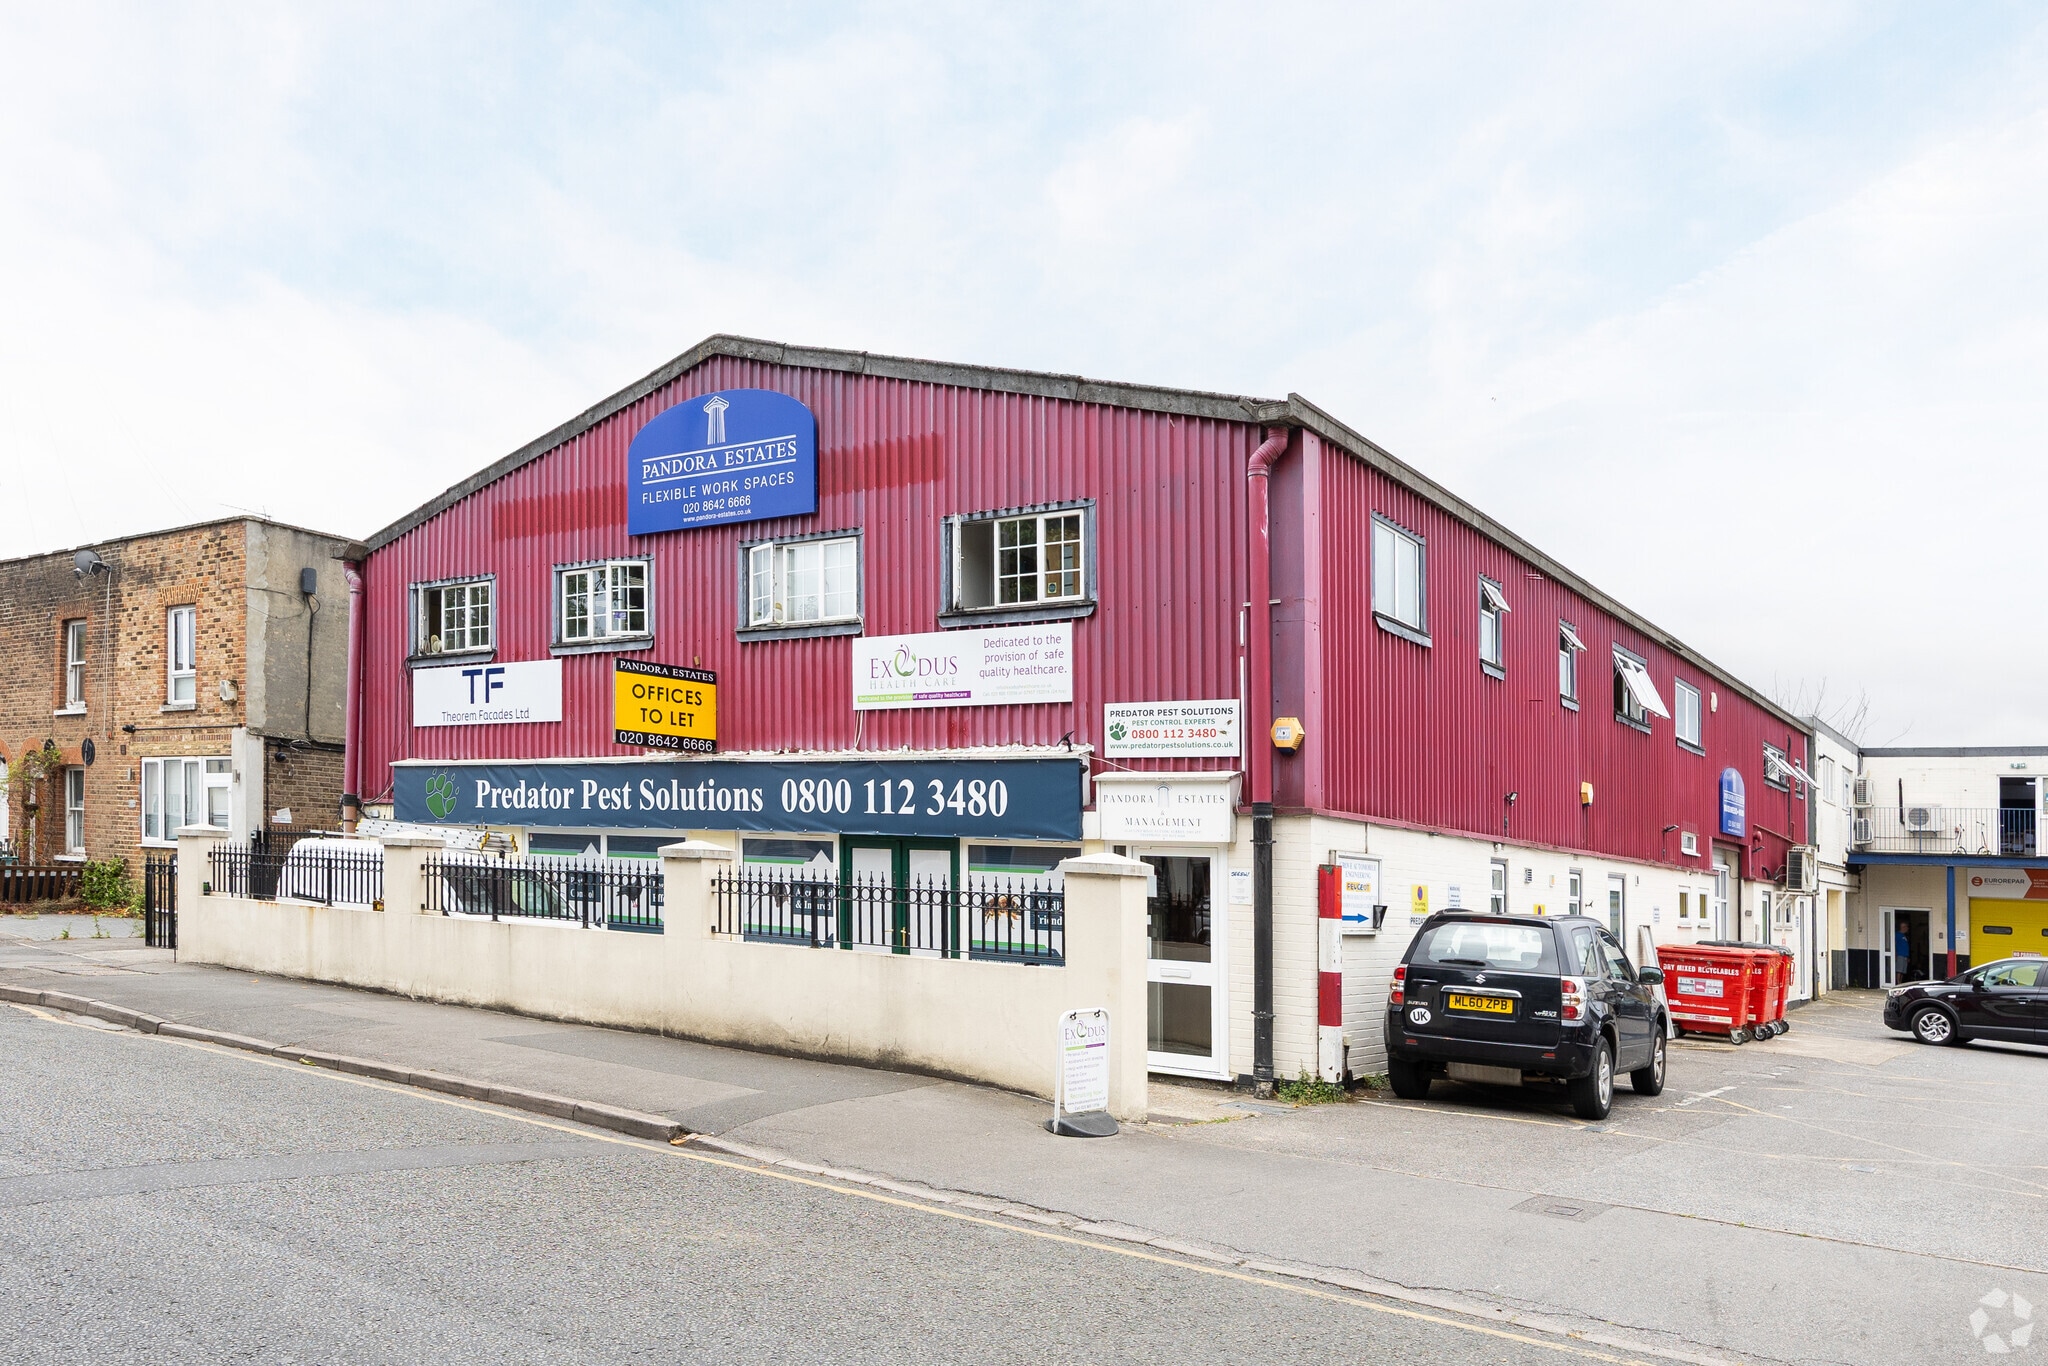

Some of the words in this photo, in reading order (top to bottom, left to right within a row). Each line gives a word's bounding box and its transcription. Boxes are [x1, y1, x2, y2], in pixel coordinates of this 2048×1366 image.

[642, 454, 718, 479] PANDORA
[725, 440, 797, 466] ESTATES
[642, 485, 697, 504] FLEXIBLE
[702, 479, 739, 496] WORK
[744, 472, 794, 490] SPACES
[683, 502, 700, 515] 020
[703, 498, 725, 512] 8642
[727, 495, 751, 509] 6666
[683, 508, 752, 523] www.pandora-estates.co.uk
[983, 635, 1030, 648] Dedicated
[1033, 636, 1043, 646] to
[1046, 634, 1062, 644] the
[870, 649, 958, 679] EXODUS
[984, 652, 1025, 665] provision
[1028, 650, 1039, 660] of
[1044, 649, 1064, 659] safe
[620, 660, 668, 675] PANDORA
[672, 668, 714, 681] ESTATES
[979, 667, 1010, 679] quality
[1013, 664, 1067, 675] healthcare.
[462, 667, 505, 704] TF
[870, 679, 916, 689] HEALTH
[925, 677, 957, 687] CARE
[632, 683, 702, 706] OFFICES
[442, 710, 477, 722] Theorem
[479, 709, 513, 721] Facades
[515, 707, 530, 719] Ltd
[640, 707, 663, 724] TO
[670, 711, 694, 727] LET
[1110, 709, 1155, 717] PREDATOR
[1157, 708, 1178, 716] PEST
[1181, 707, 1234, 716] SOLUTIONS
[620, 731, 643, 744] 020
[648, 734, 678, 748] 8642
[683, 738, 713, 751] 6666
[1131, 729, 1159, 739] 0800
[1163, 729, 1184, 738] 112
[1188, 728, 1217, 738] 3480
[1110, 741, 1234, 750] www.predatorpestsolutions.co.uk
[475, 779, 574, 809] Predator
[581, 779, 631, 810] Pest
[639, 778, 764, 811] Solutions
[781, 778, 852, 814] 0800
[863, 778, 916, 815] 112
[926, 779, 1009, 817] 3480
[1103, 794, 1154, 804] PANDORA
[1178, 794, 1225, 804] ESTATES
[1124, 817, 1202, 827] MANAGEMENT
[795, 901, 802, 909] &
[1676, 964, 1696, 973] MIXED
[1697, 966, 1740, 976] RECYCLABLES
[1455, 996, 1483, 1008] ML60
[1486, 998, 1508, 1010] ZPB
[1412, 1011, 1428, 1021] UK
[1065, 1022, 1105, 1040] EXODUS
